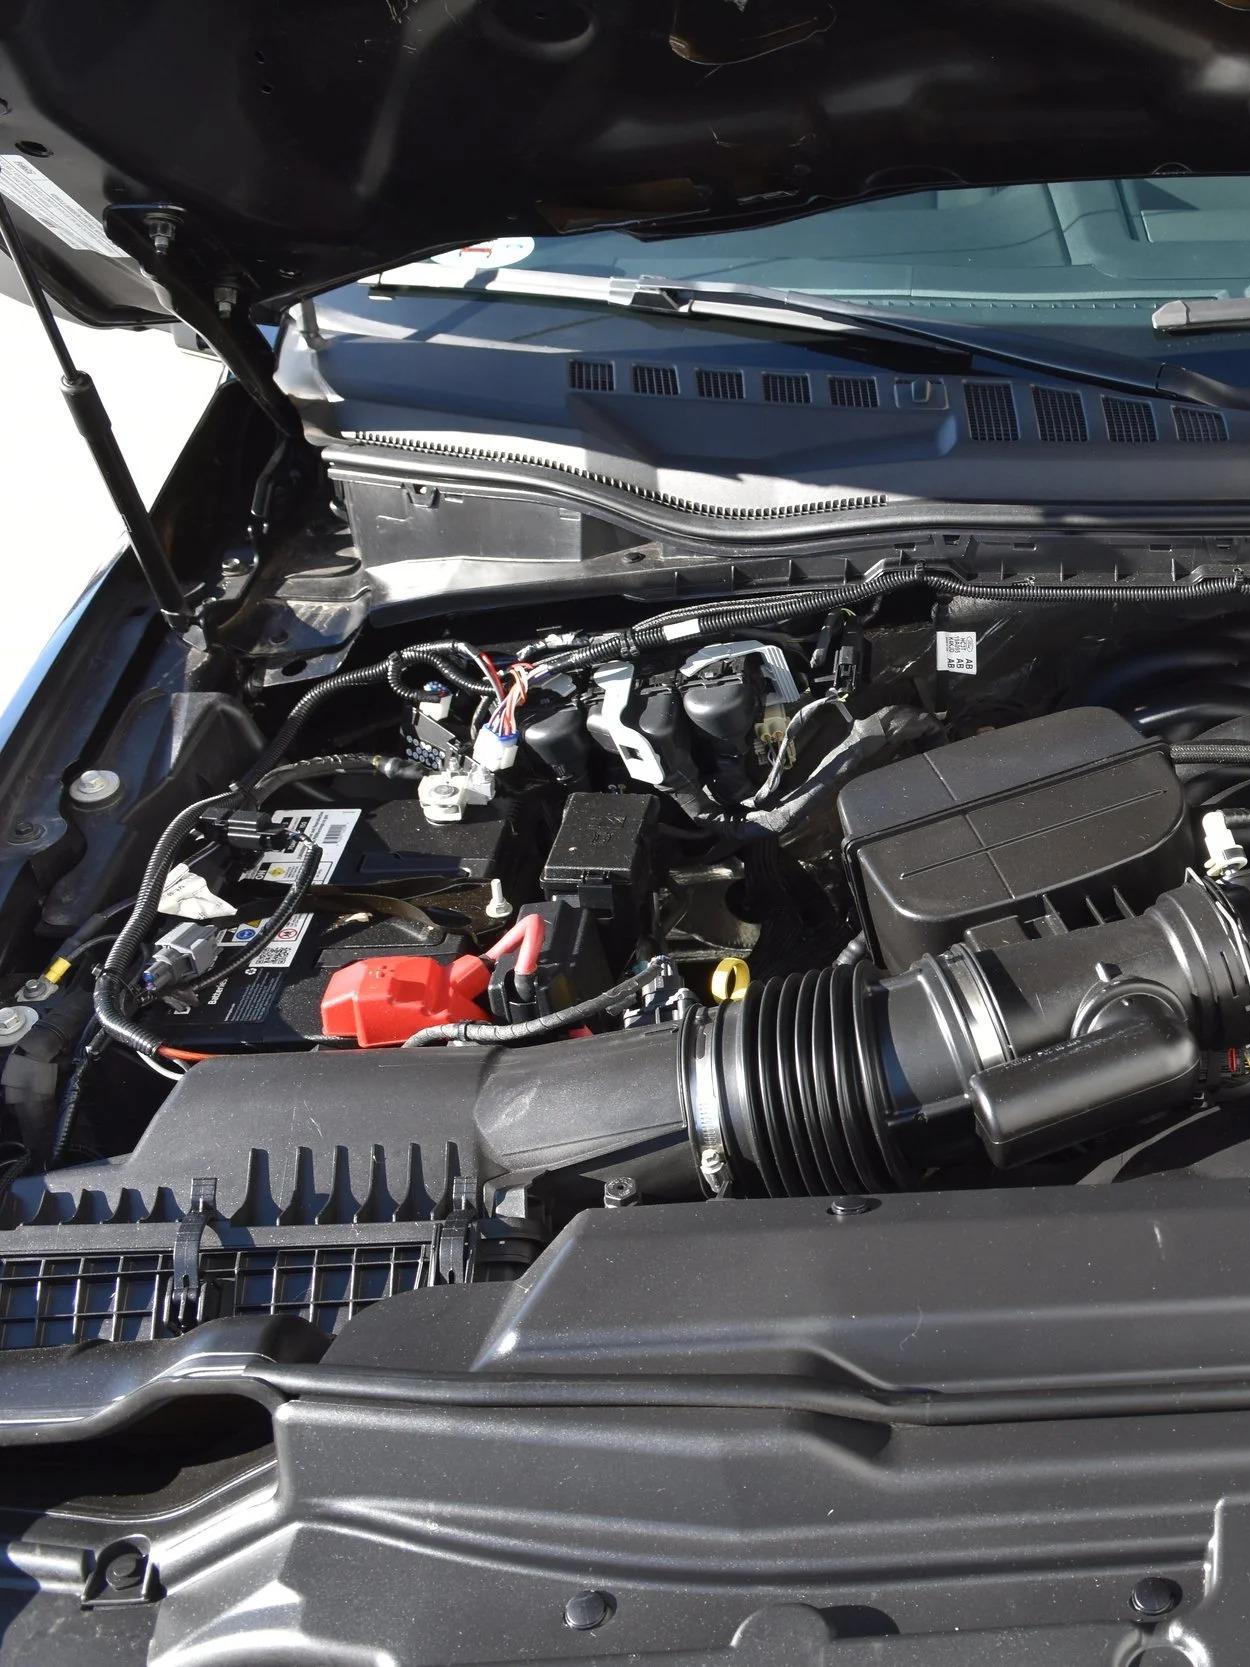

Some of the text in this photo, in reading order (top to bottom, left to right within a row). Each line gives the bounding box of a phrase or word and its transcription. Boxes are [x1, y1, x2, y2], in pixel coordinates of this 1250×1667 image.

[947, 658, 955, 669] AB
[956, 658, 964, 669] AB
[965, 658, 973, 669] AB
